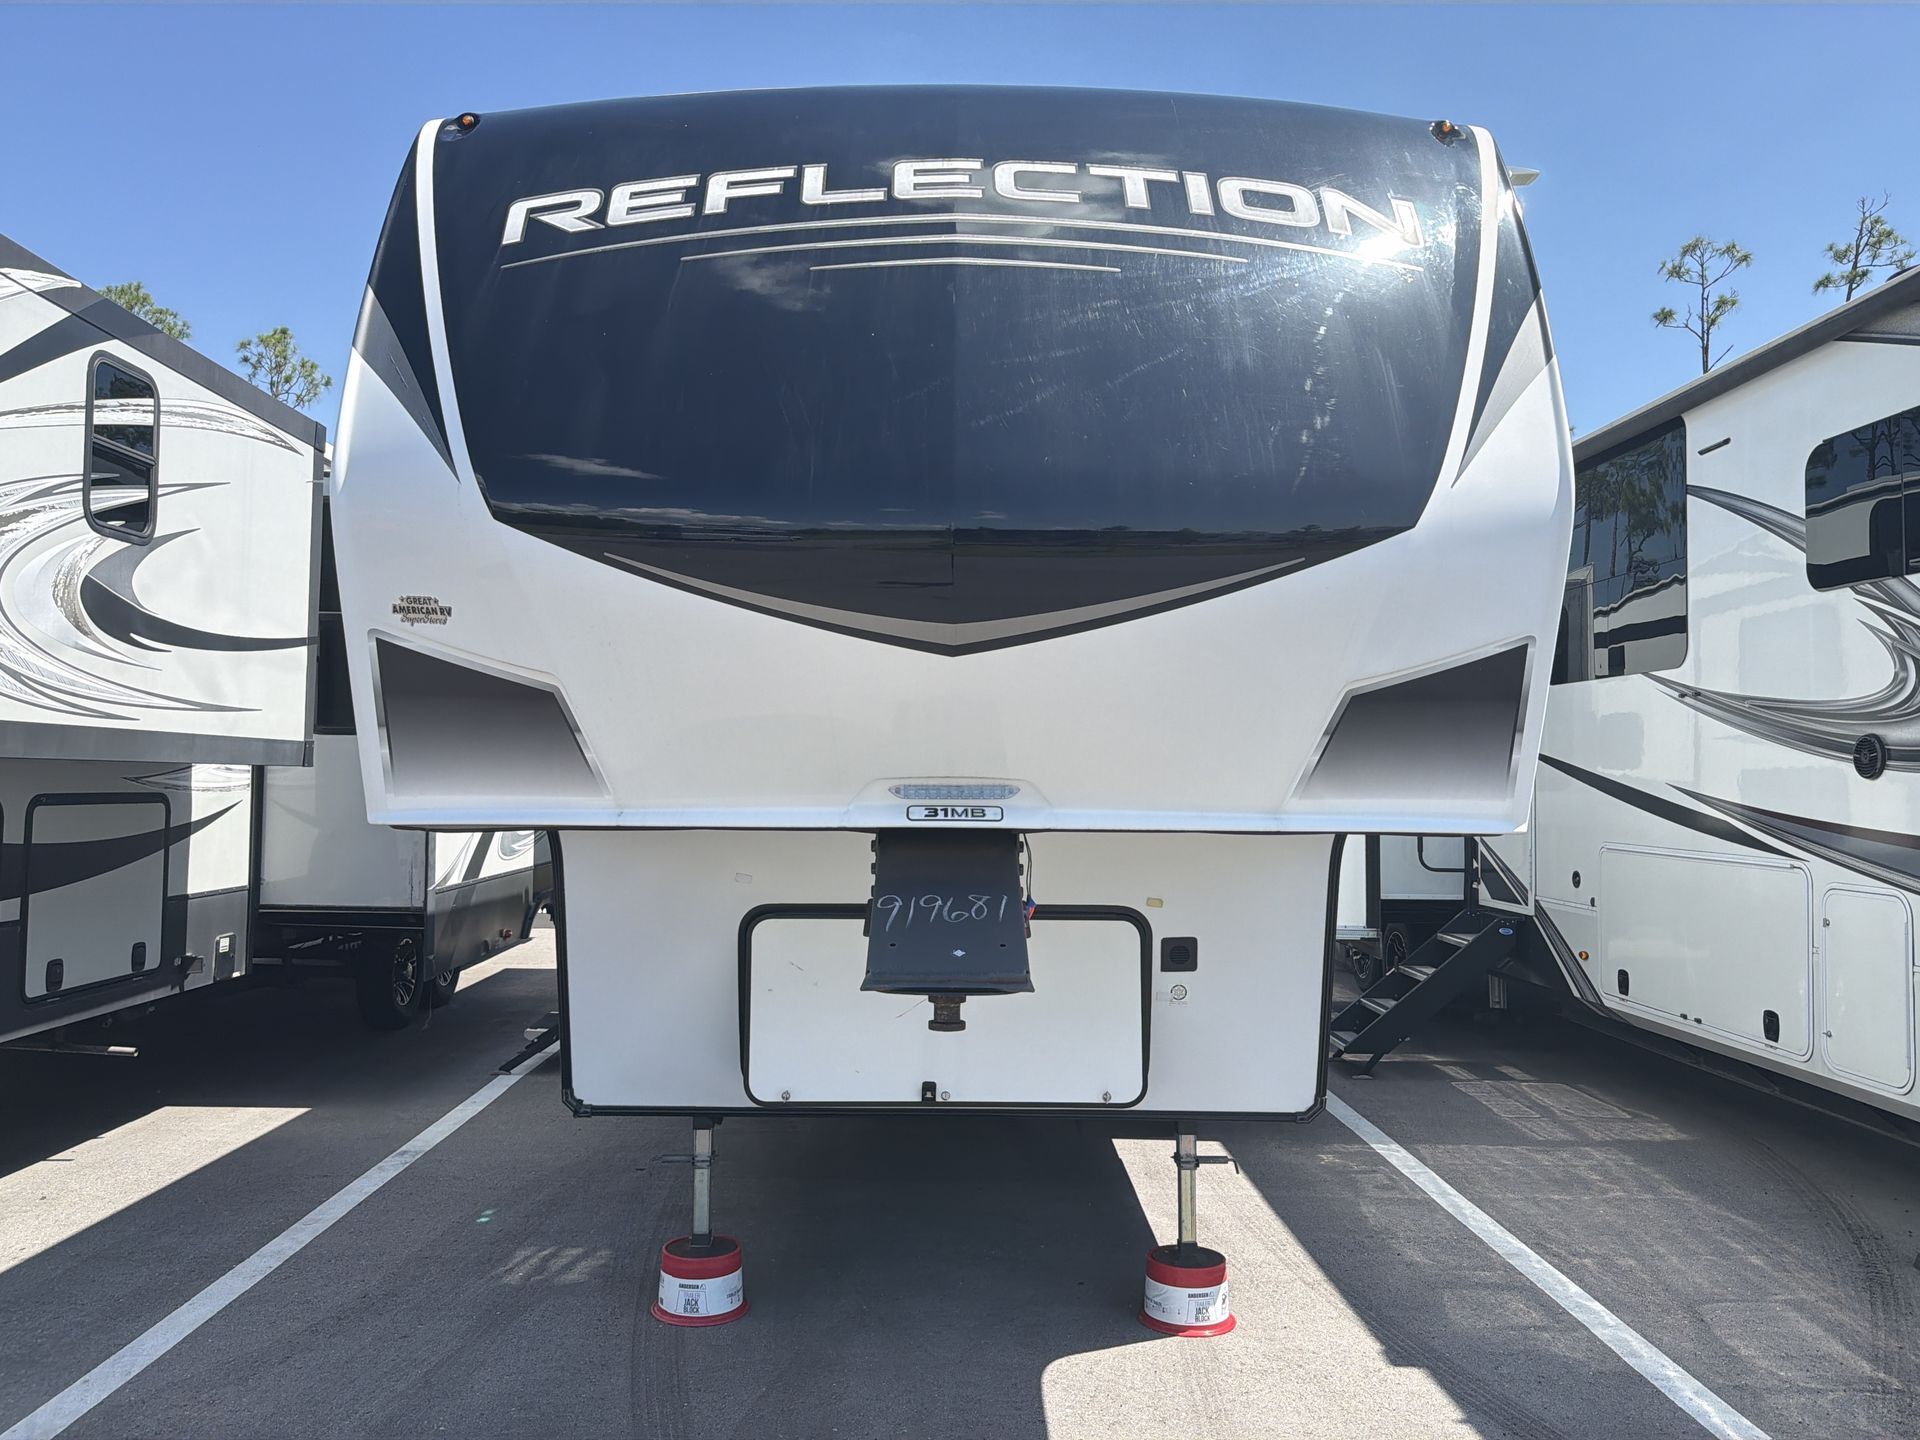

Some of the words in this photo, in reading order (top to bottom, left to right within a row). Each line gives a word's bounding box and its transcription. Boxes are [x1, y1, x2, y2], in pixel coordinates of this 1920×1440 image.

[501, 158, 1424, 248] REFLECTION
[406, 597, 432, 606] GREAT
[392, 604, 438, 615] AMERICAN
[440, 606, 452, 617] RV
[924, 807, 986, 818] 31MB
[877, 895, 1008, 932] 919681
[684, 1298, 699, 1307] JACK
[1196, 1306, 1209, 1315] JACK
